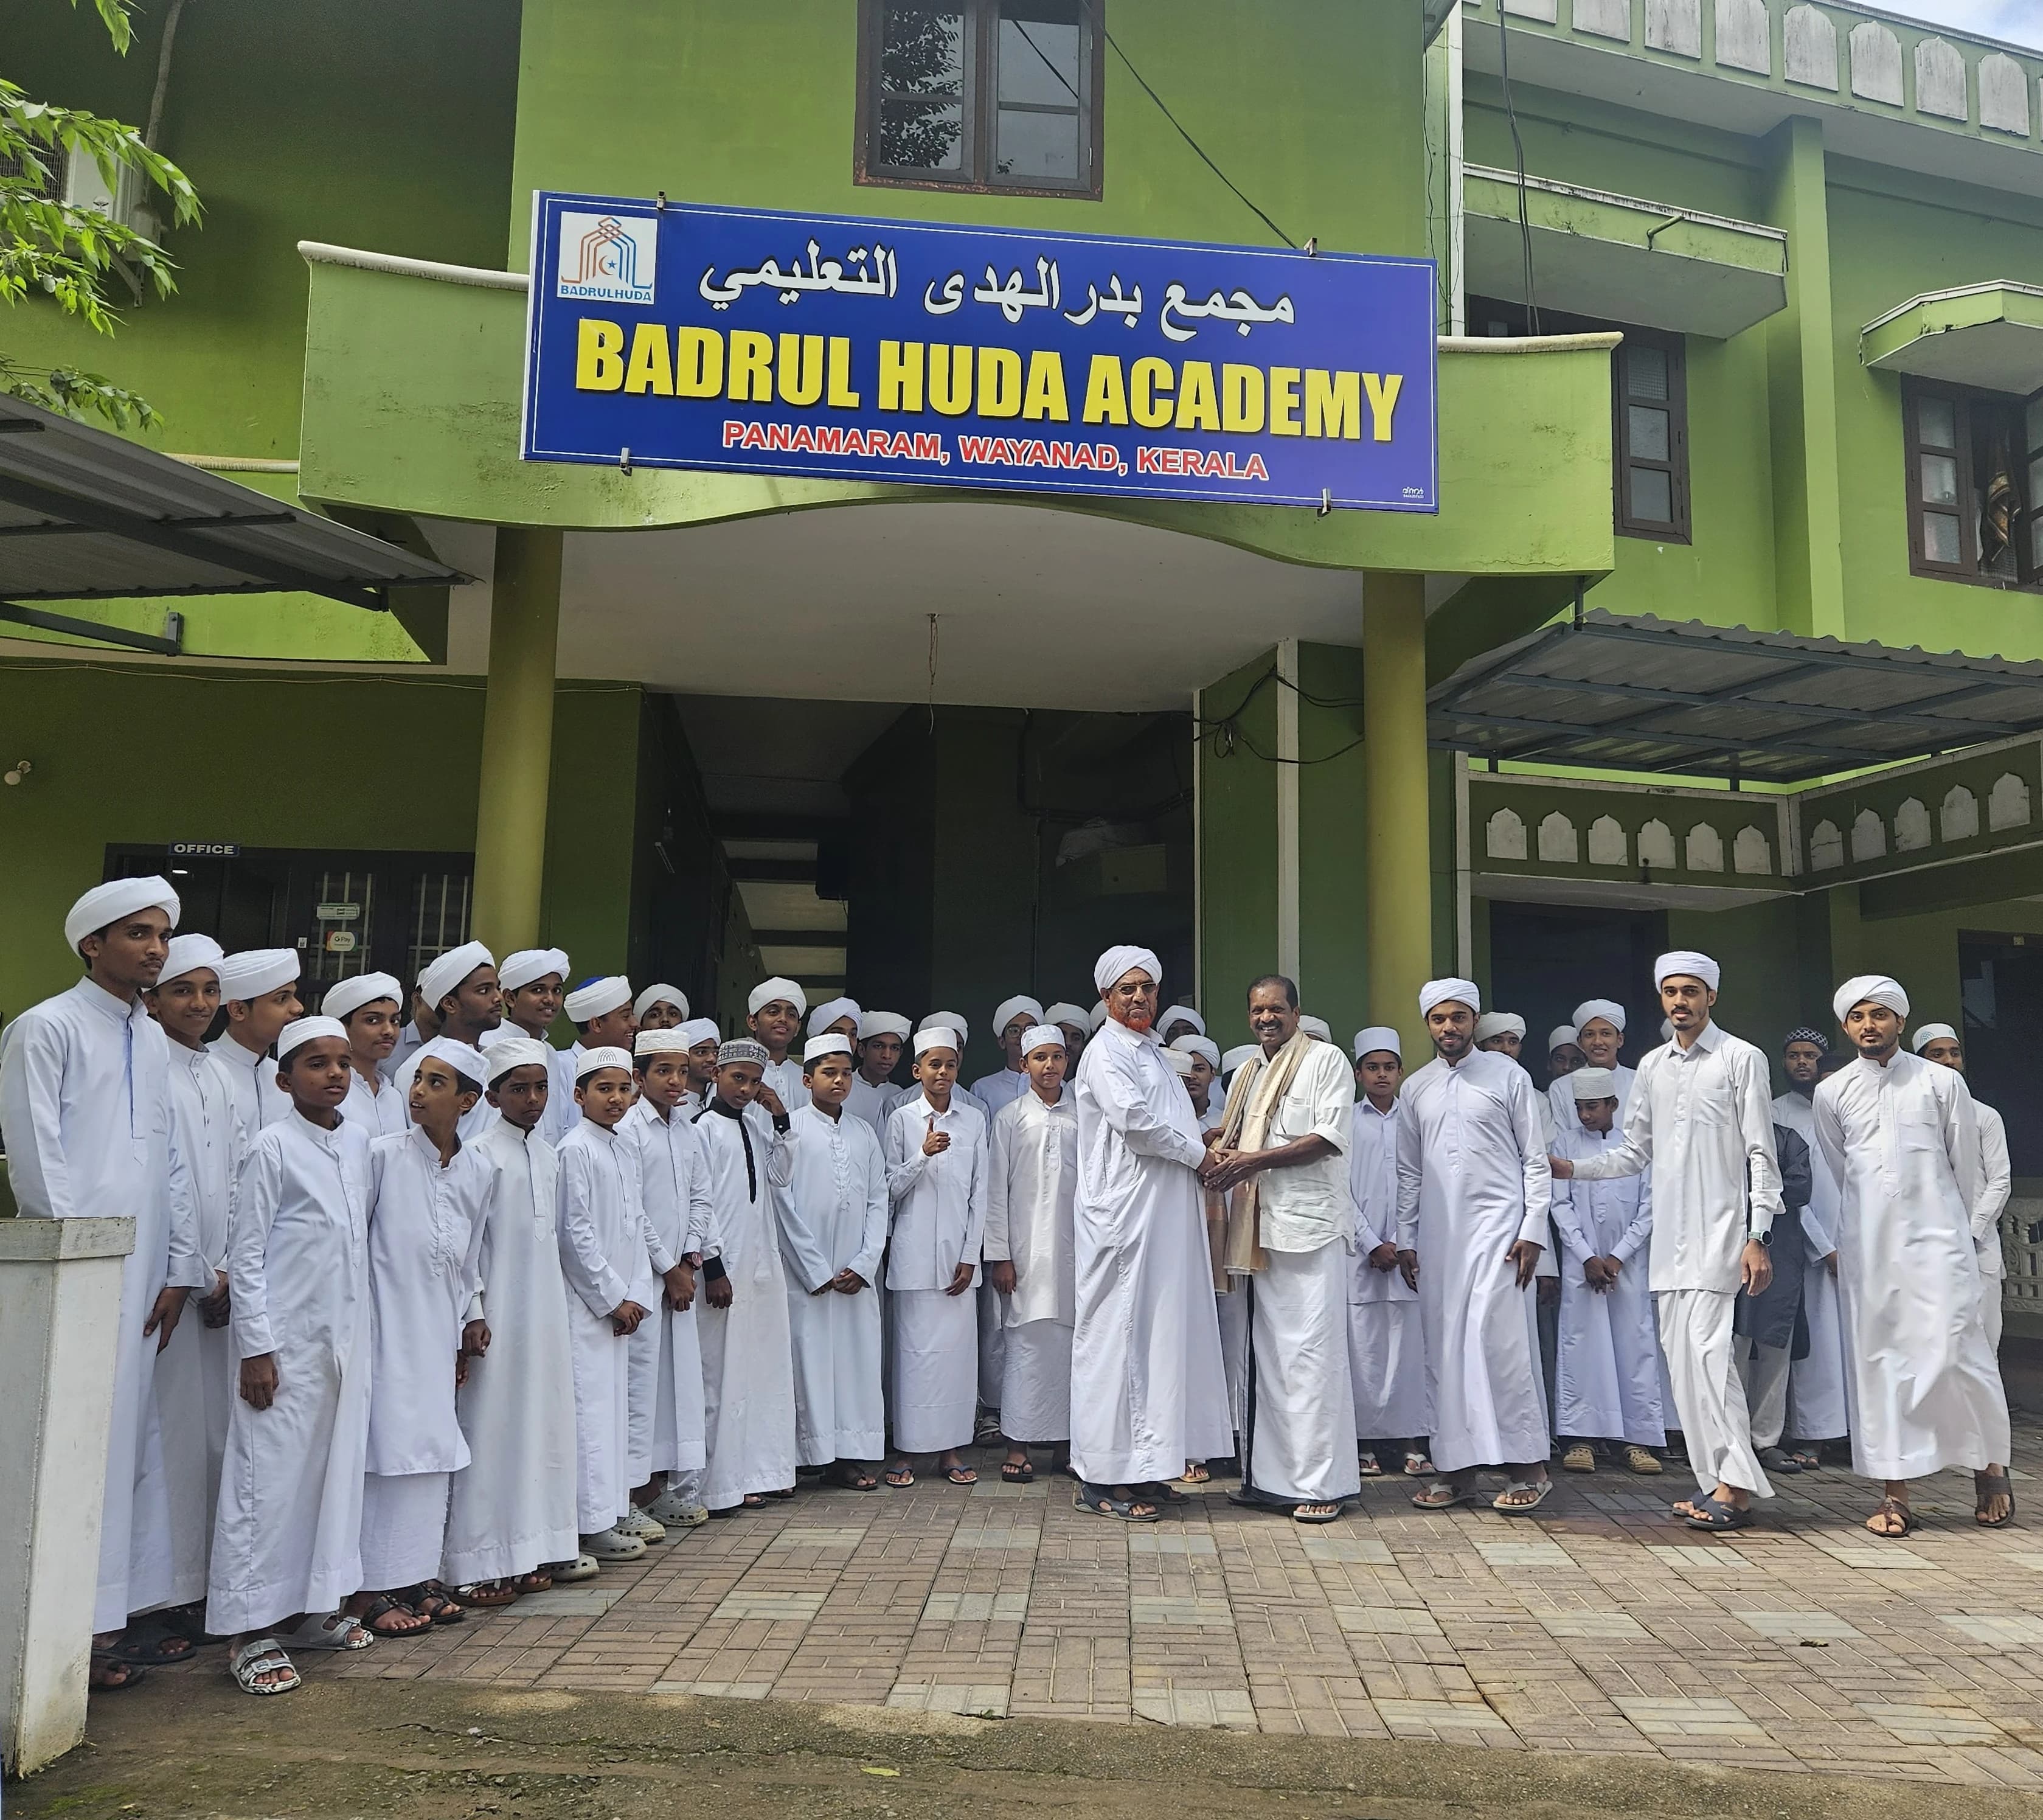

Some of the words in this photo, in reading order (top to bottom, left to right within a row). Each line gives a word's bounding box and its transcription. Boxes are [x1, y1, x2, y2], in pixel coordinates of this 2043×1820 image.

[561, 285, 651, 302] BADRULHUDA
[699, 239, 898, 311] التعليمي
[924, 256, 1060, 324] الهدى
[1063, 274, 1142, 329] بدر
[1160, 283, 1295, 341] مجمع
[575, 319, 860, 408] BADRUL
[878, 341, 1069, 422] HUDA
[1083, 355, 1403, 442] ACADEMY
[723, 420, 951, 465] PANAMARAM,
[957, 435, 1128, 477] WAYANAD,
[1136, 446, 1269, 481] KERALA
[174, 844, 234, 855] OFFICE
